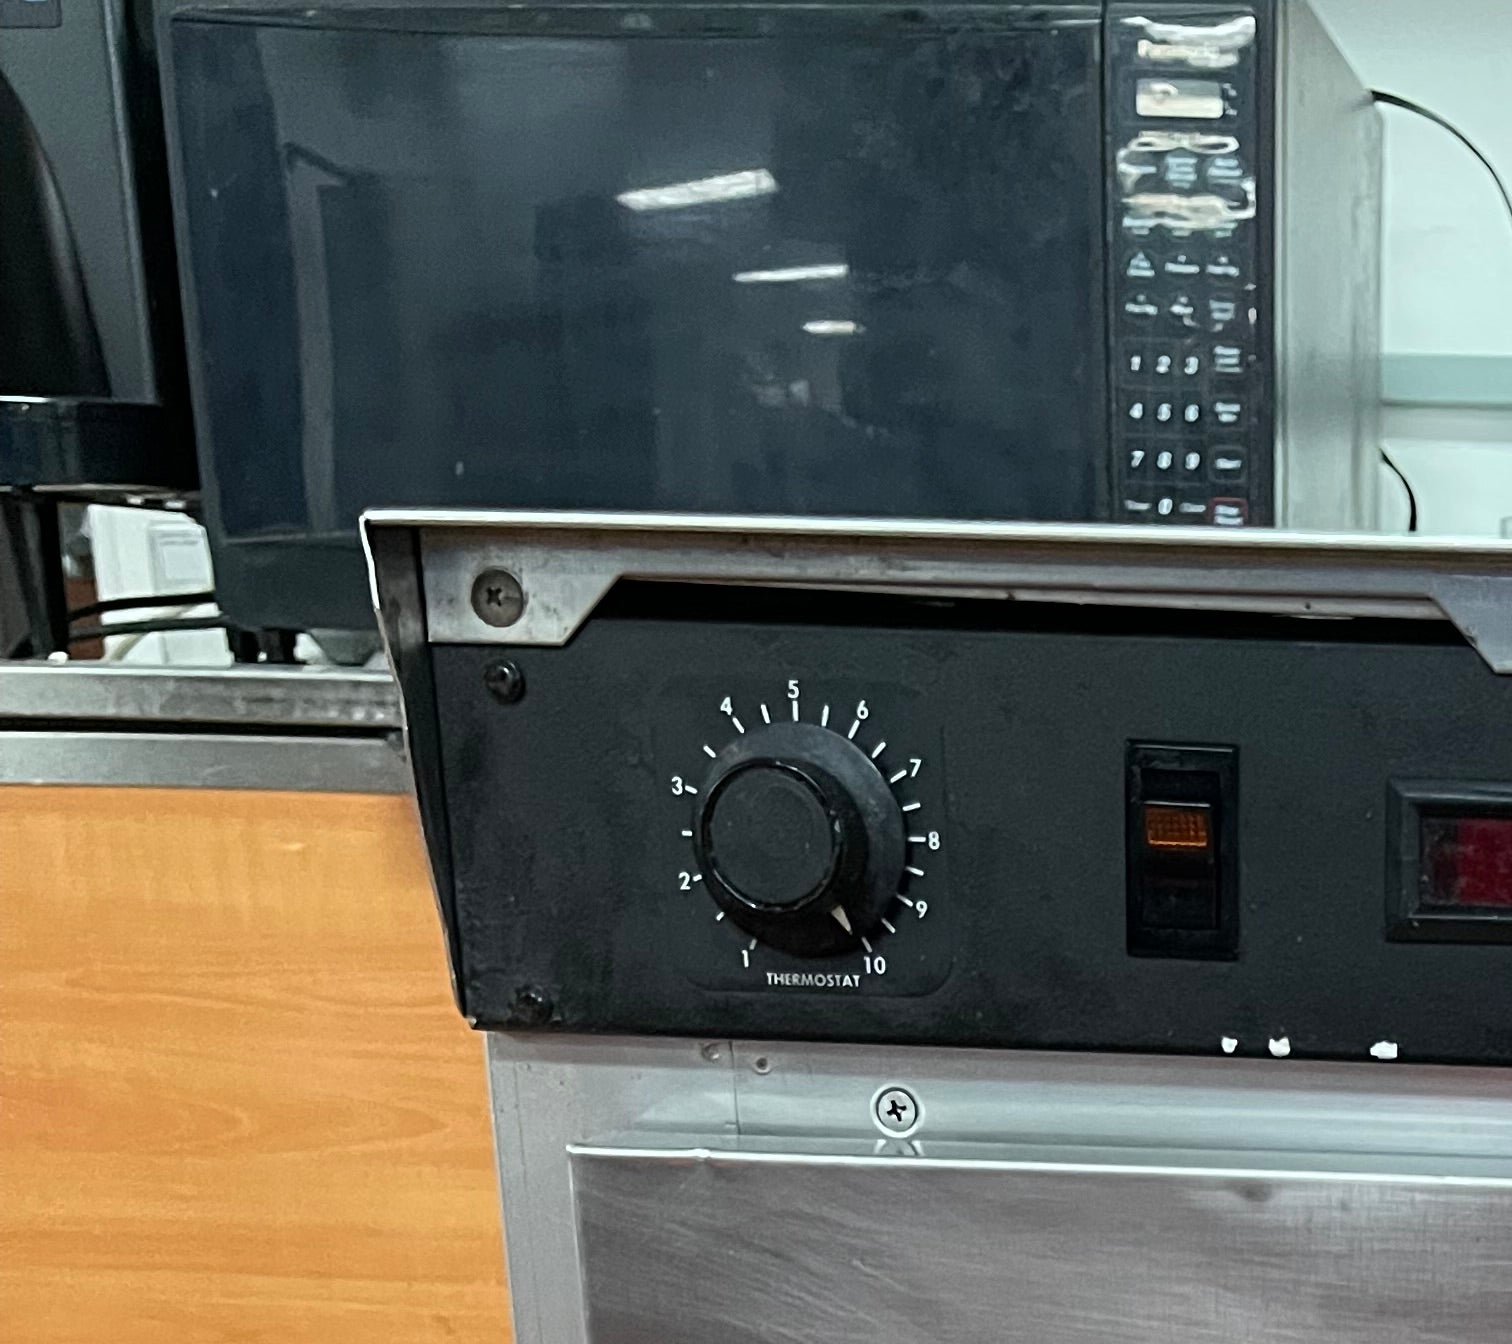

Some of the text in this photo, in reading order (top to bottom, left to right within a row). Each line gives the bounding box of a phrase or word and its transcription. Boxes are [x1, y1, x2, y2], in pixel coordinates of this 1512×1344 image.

[1131, 450, 1145, 467] 7
[787, 680, 799, 699] 5
[720, 697, 733, 716] 4
[856, 700, 869, 720] 6
[910, 758, 922, 777] 7
[671, 776, 684, 795] 3
[927, 831, 940, 850] 8
[678, 872, 691, 890] 2
[915, 900, 928, 918] 9
[741, 949, 749, 968] 1
[863, 956, 886, 975] 10
[766, 972, 860, 987] THERMOSTAT
